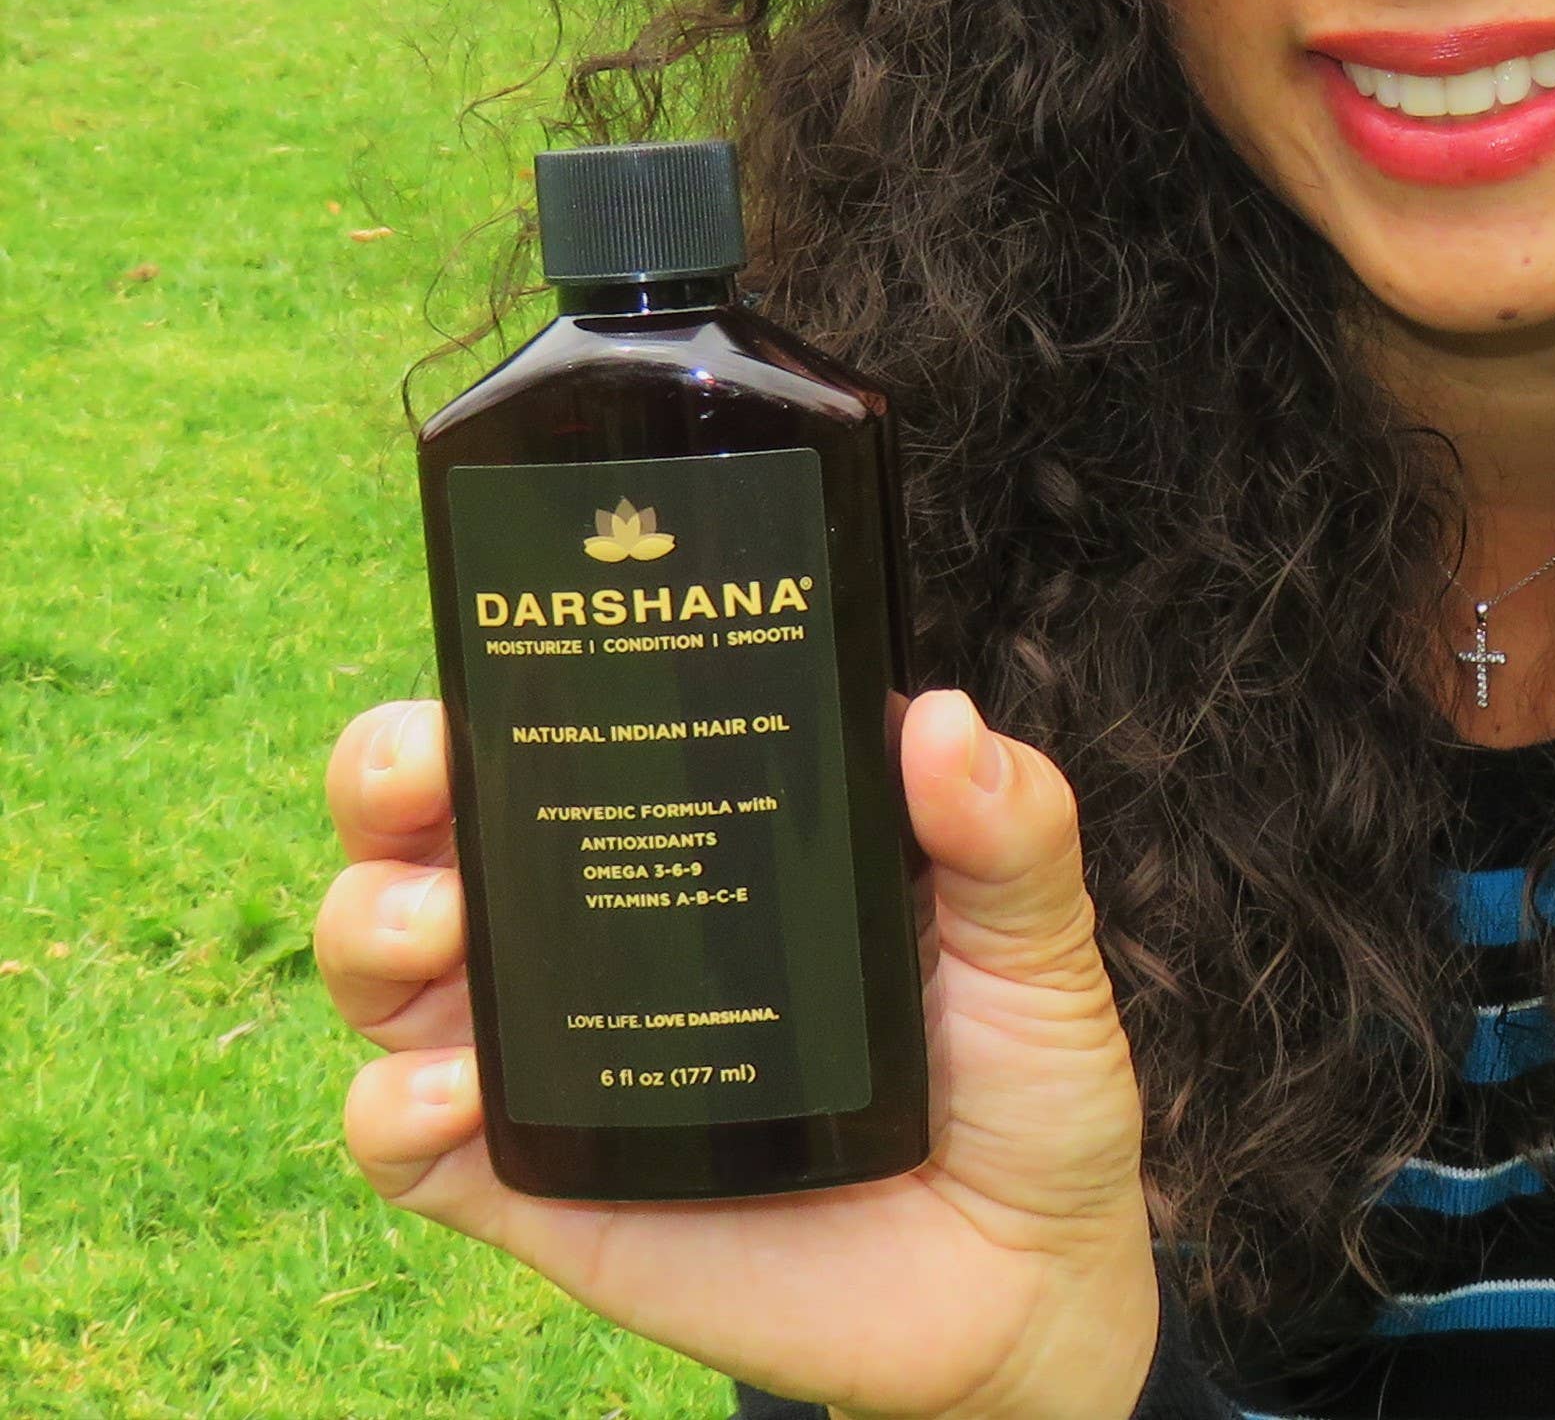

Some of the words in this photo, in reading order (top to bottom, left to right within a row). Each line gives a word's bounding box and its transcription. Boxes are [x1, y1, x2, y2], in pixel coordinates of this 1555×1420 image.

[487, 640, 582, 655] MOISTURIZE
[604, 634, 703, 652] CONDITION
[727, 626, 803, 645] SMOOTH
[513, 727, 605, 742] NATURAL
[611, 723, 686, 741] INDIAN
[693, 719, 746, 737] HAIR
[752, 715, 789, 732] OIL
[537, 806, 635, 820] AYURVEDIC
[641, 801, 732, 818] FORMULA
[738, 796, 777, 812] with
[581, 832, 717, 850] ANTIOXIDANTS
[584, 865, 648, 879] OMEGA
[655, 862, 702, 878] 3-6-9
[586, 893, 670, 908] VITAMINS
[677, 888, 748, 906] A-B-C-E
[568, 1015, 604, 1028] LOVE
[608, 1015, 642, 1028] LIFE.
[645, 1014, 685, 1027] LOVE
[688, 1008, 779, 1026] DARSHANA.
[601, 1070, 614, 1086] 6
[619, 1069, 633, 1086] fl
[639, 1073, 664, 1085] oz
[671, 1067, 712, 1087] (177
[721, 1064, 755, 1083] ml)
